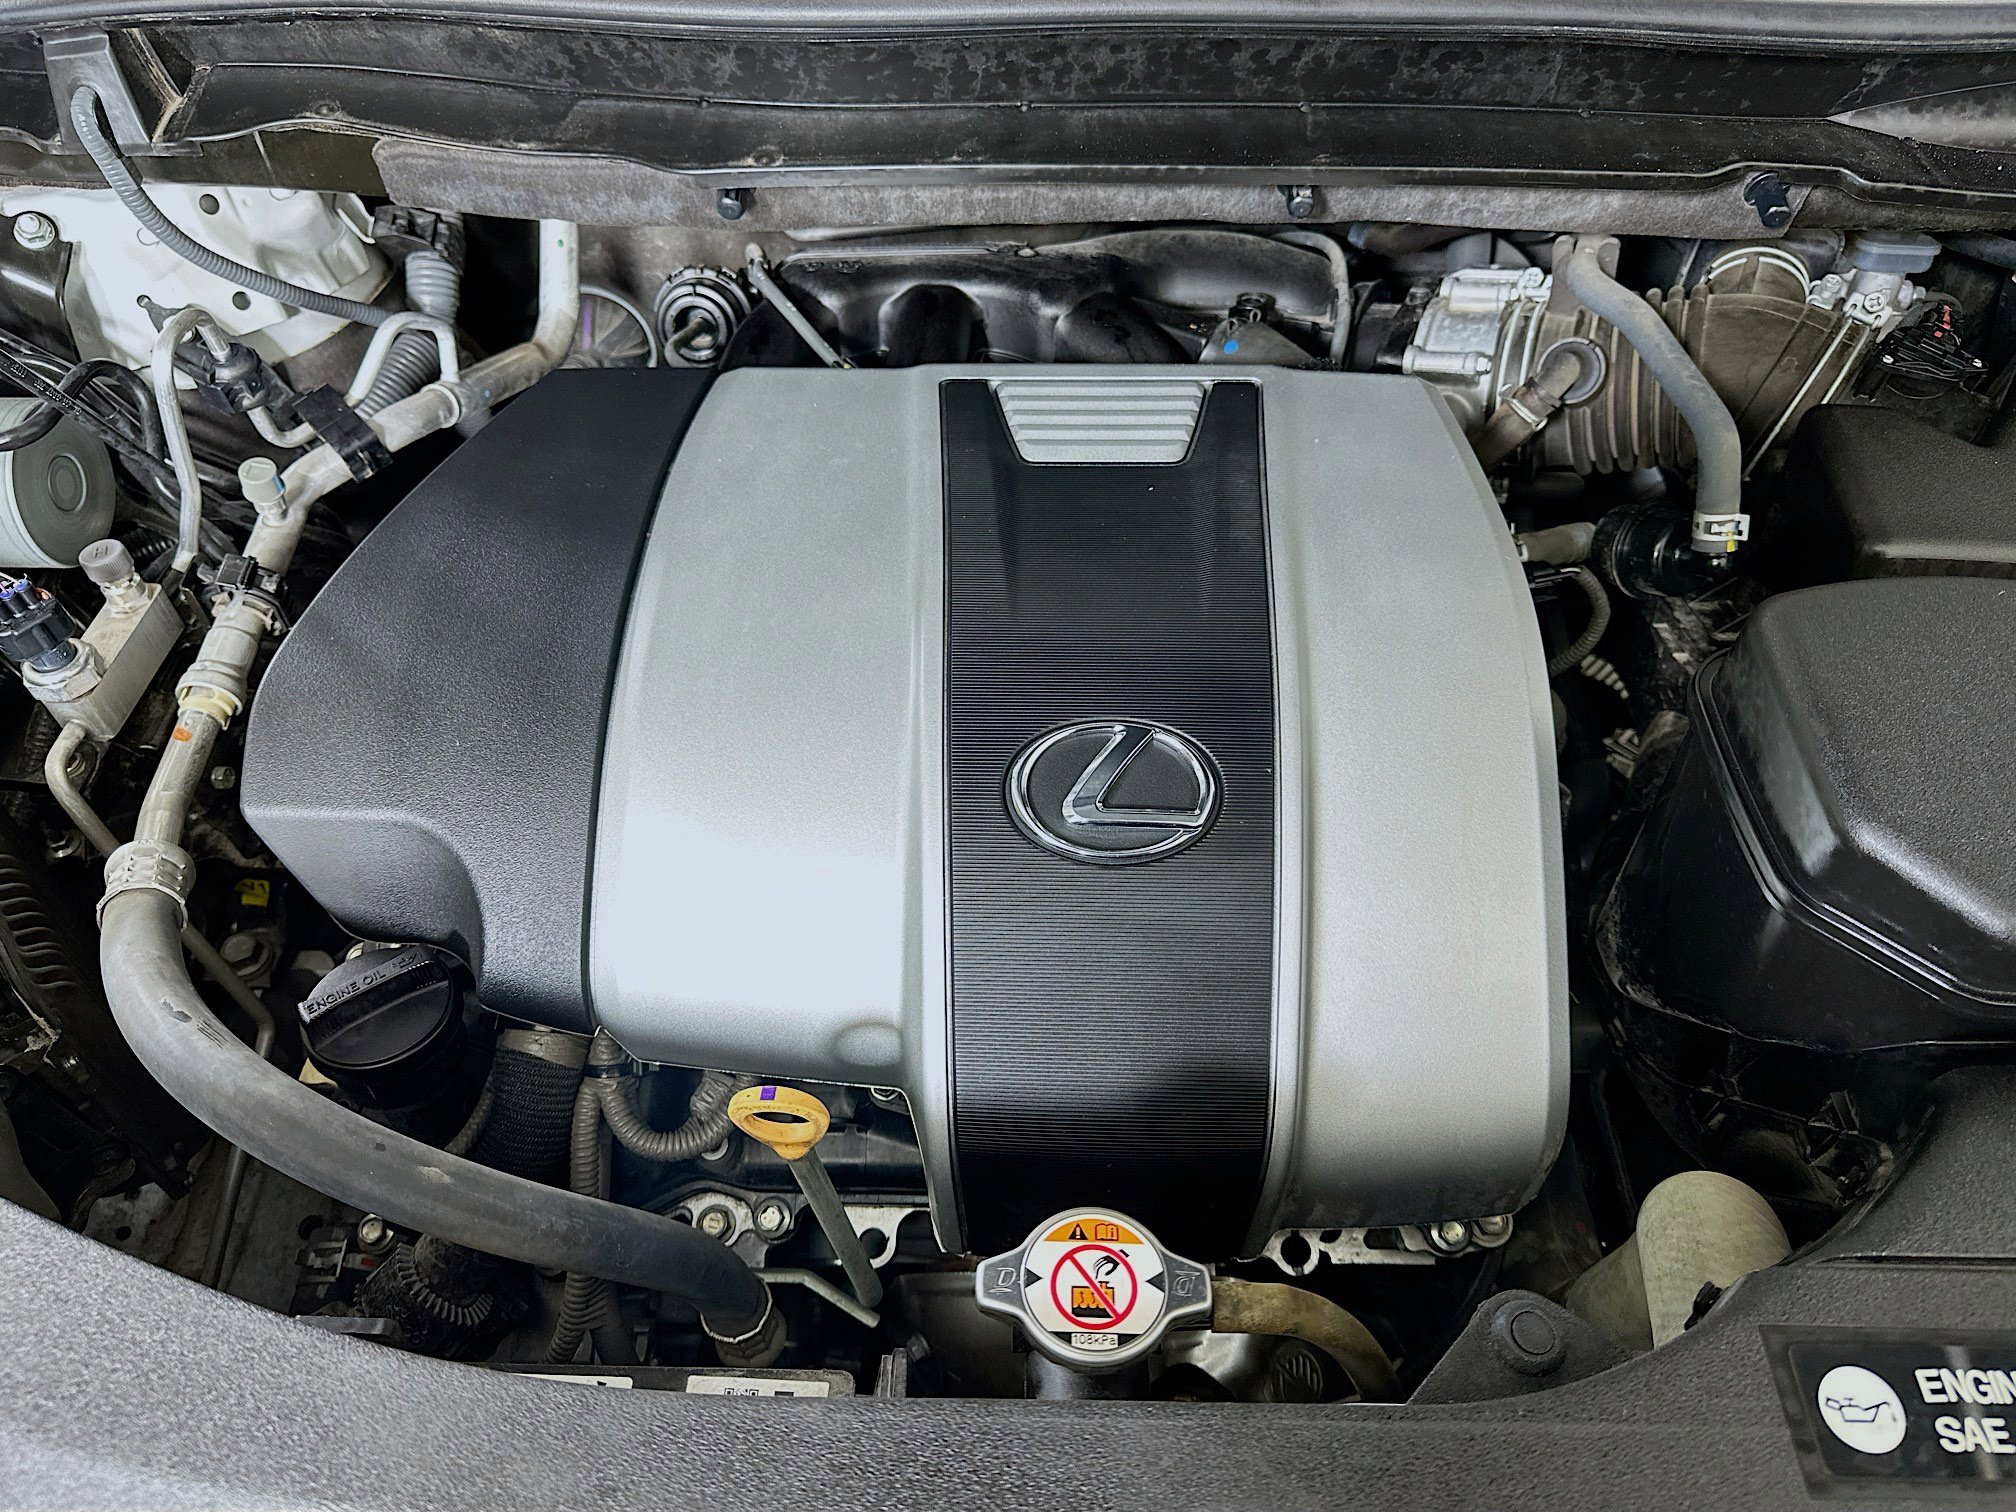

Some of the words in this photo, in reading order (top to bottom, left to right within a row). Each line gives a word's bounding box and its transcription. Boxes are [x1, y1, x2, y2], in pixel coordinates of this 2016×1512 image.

[306, 981, 361, 1015] ENGINE
[362, 970, 387, 986] OIL
[1072, 1334, 1117, 1346] 108kPa
[1934, 1415, 2016, 1454] SAE
